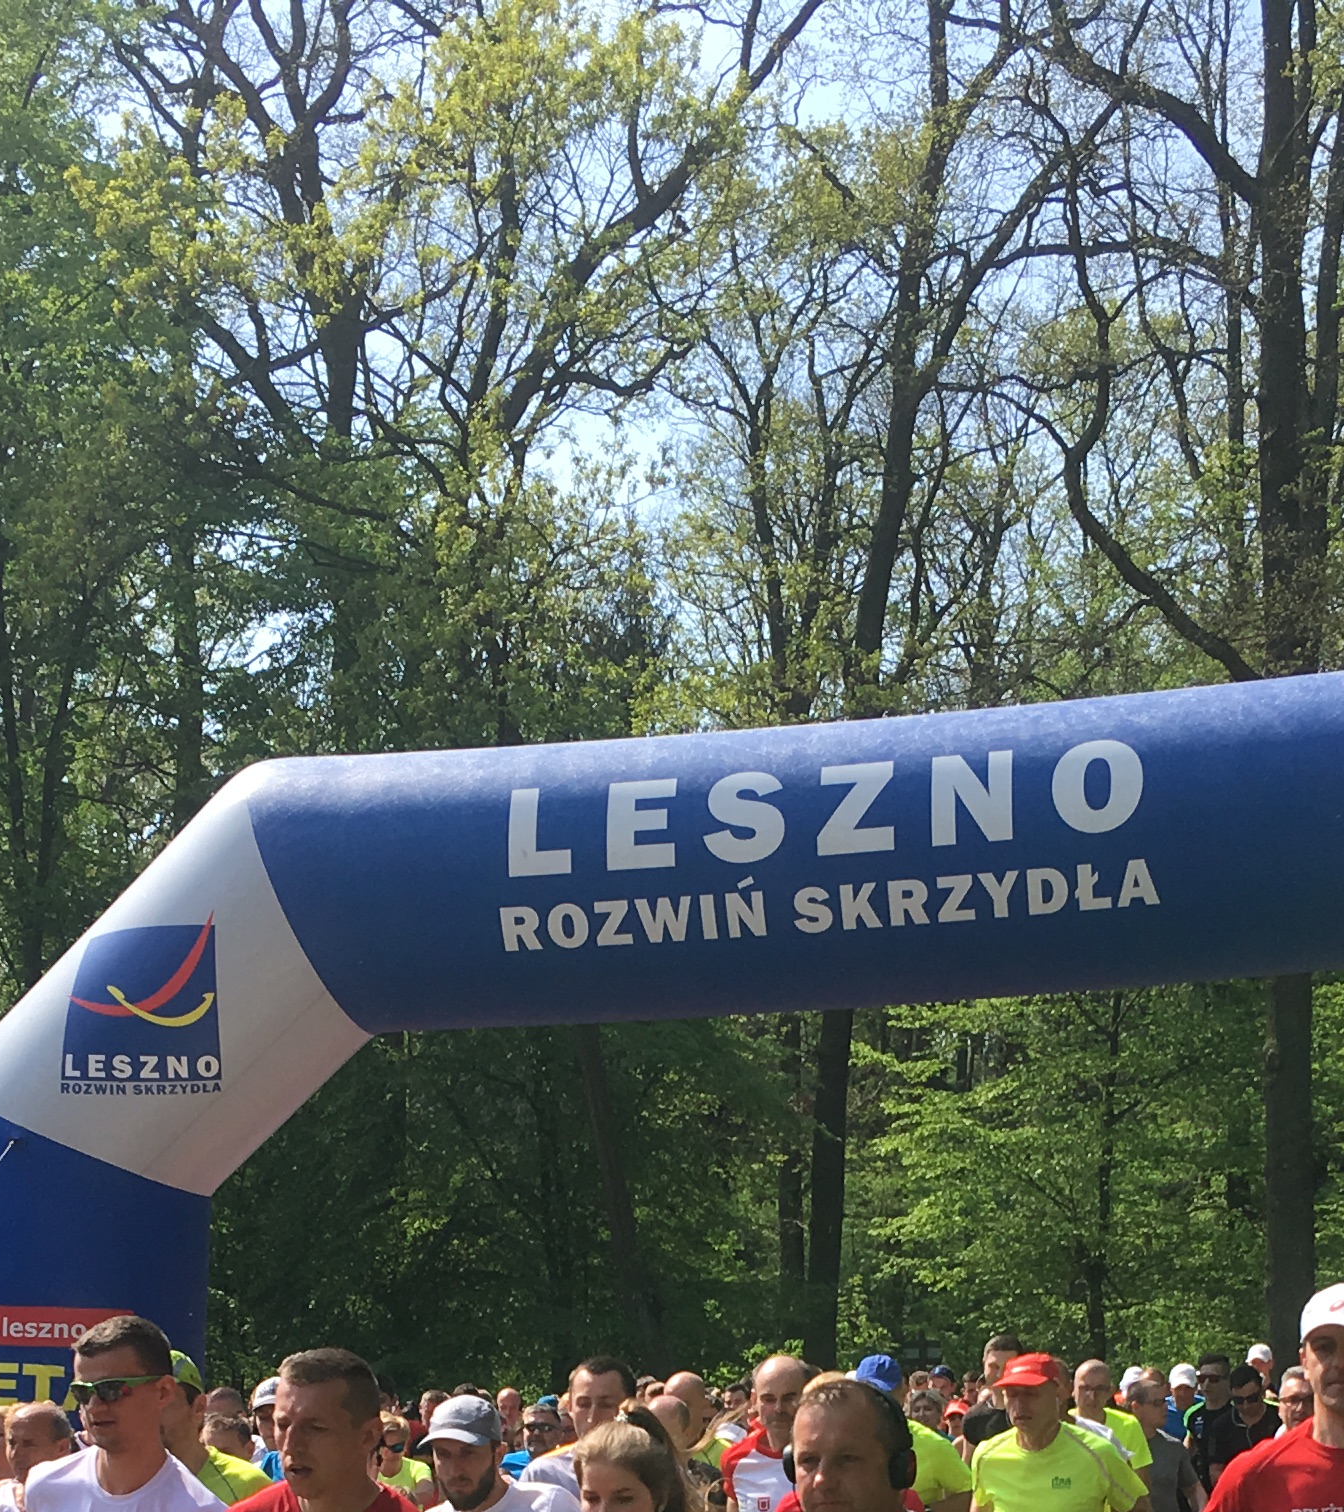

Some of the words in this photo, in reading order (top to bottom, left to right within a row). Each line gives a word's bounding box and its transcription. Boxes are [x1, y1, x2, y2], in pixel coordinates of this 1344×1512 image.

[507, 739, 1144, 878] LESZNO
[499, 877, 768, 952] ROZWIŃ
[793, 858, 1161, 935] SKRZYDŁA
[64, 1054, 220, 1080] LESZNO
